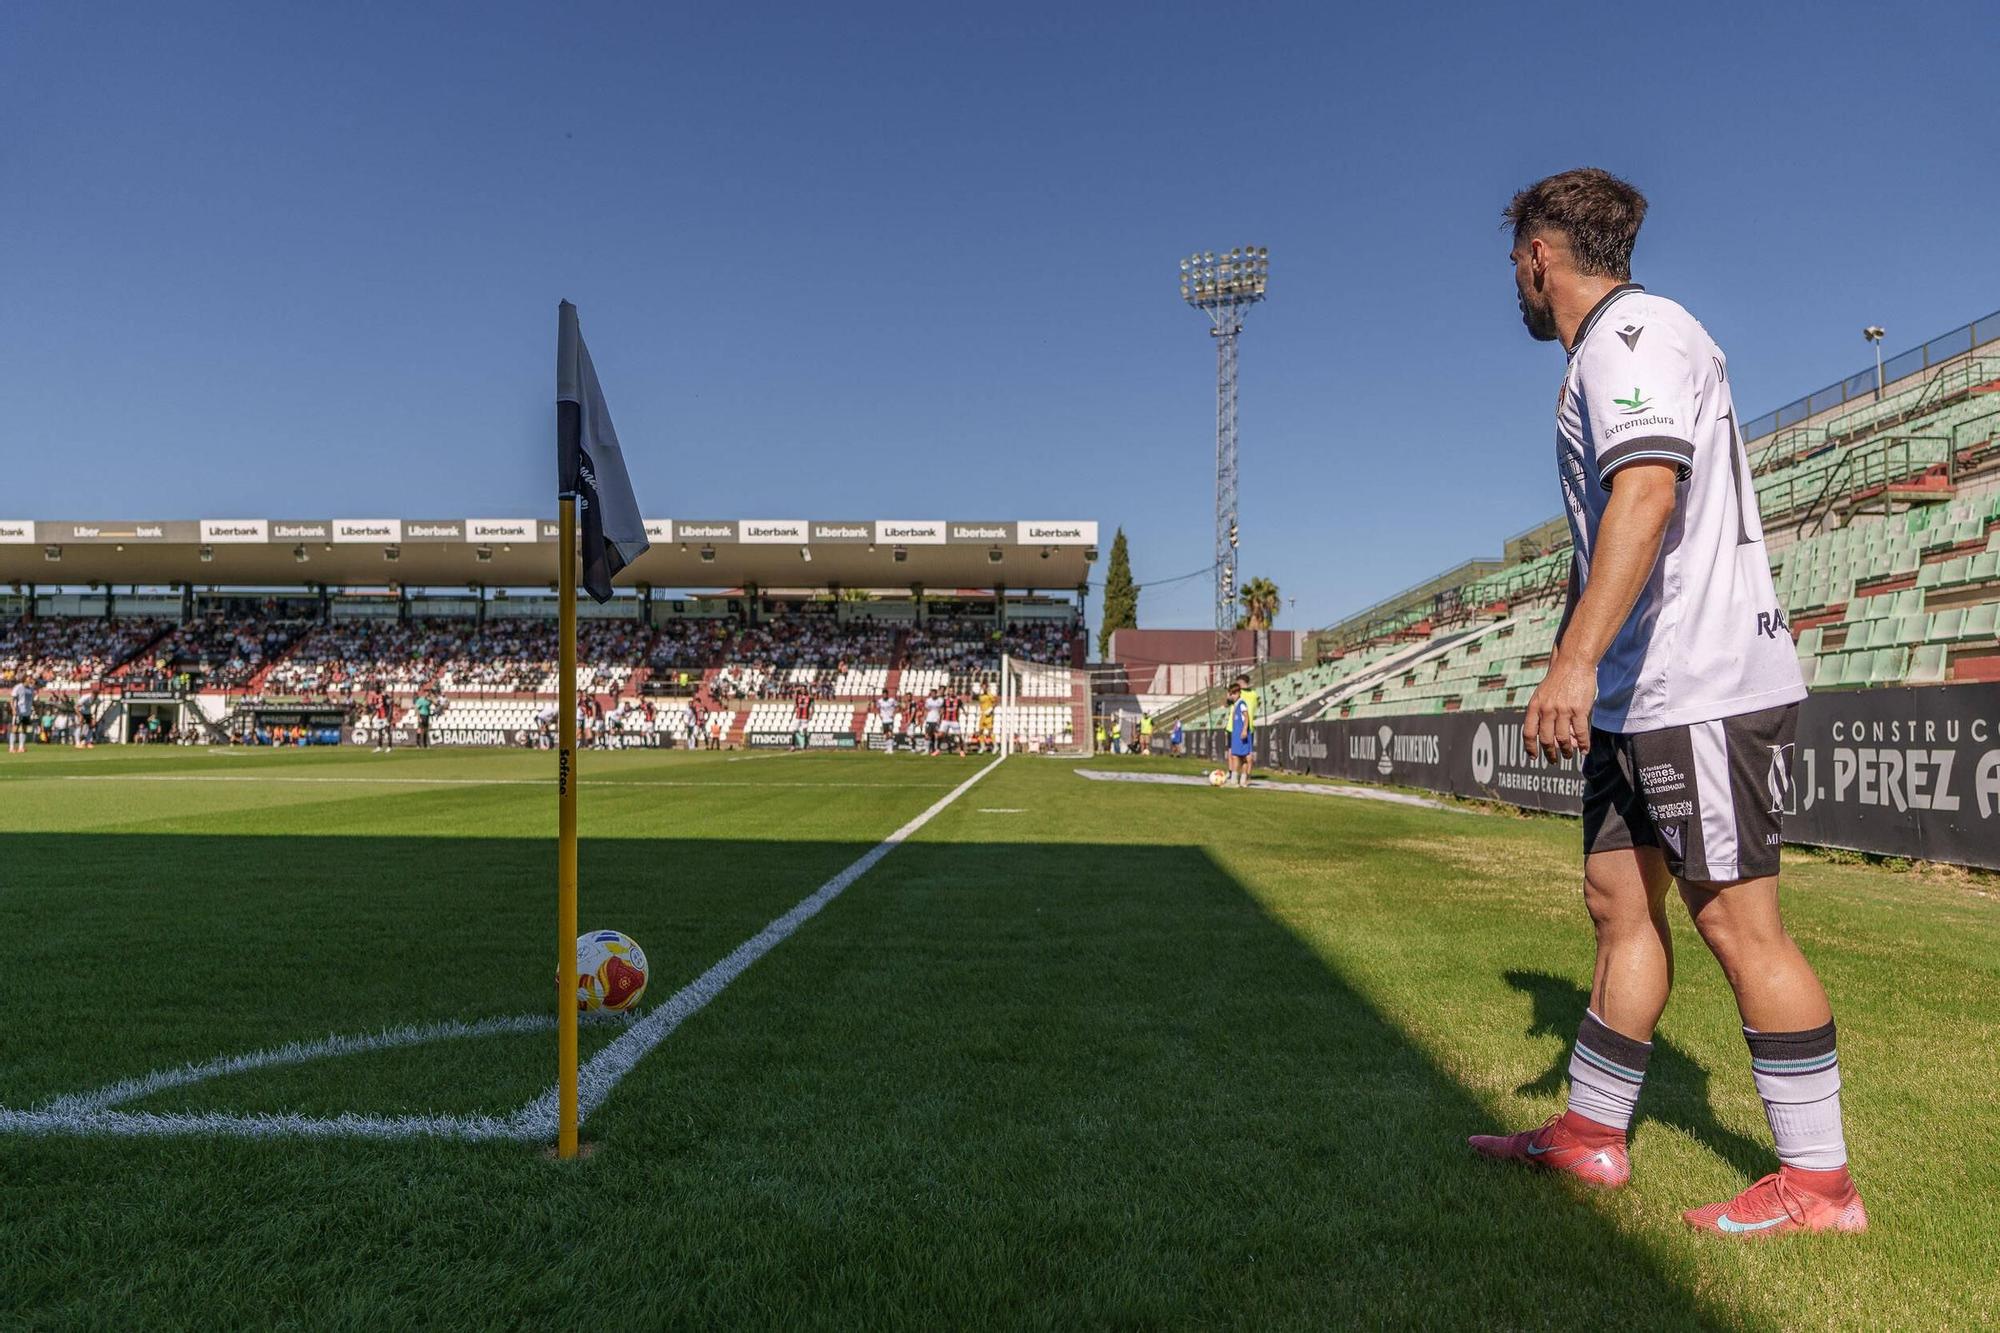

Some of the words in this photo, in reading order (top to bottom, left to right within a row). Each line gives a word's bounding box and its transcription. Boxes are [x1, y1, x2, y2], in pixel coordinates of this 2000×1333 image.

[1605, 415, 1675, 439] Extremadura
[73, 526, 100, 537] Liber
[136, 526, 162, 537] bank
[209, 527, 258, 536] Liberbank
[274, 526, 325, 537] Liberbank
[341, 527, 391, 536] Liberbank
[408, 526, 459, 536] Liberbank
[475, 526, 525, 536] Liberbank
[680, 526, 731, 537] Liberbank
[747, 527, 799, 537] Liberbank
[816, 527, 867, 537] Liberbank
[884, 528, 936, 537] Liberbank
[954, 527, 1006, 538] Liberbank
[1029, 528, 1081, 538] Liberbank
[1832, 718, 2000, 743] CONSTRUC
[443, 729, 506, 745] BADAROMA
[1498, 772, 1539, 792] TABERNEO
[1802, 748, 1825, 811] J.
[1832, 747, 1961, 813] PEREZ
